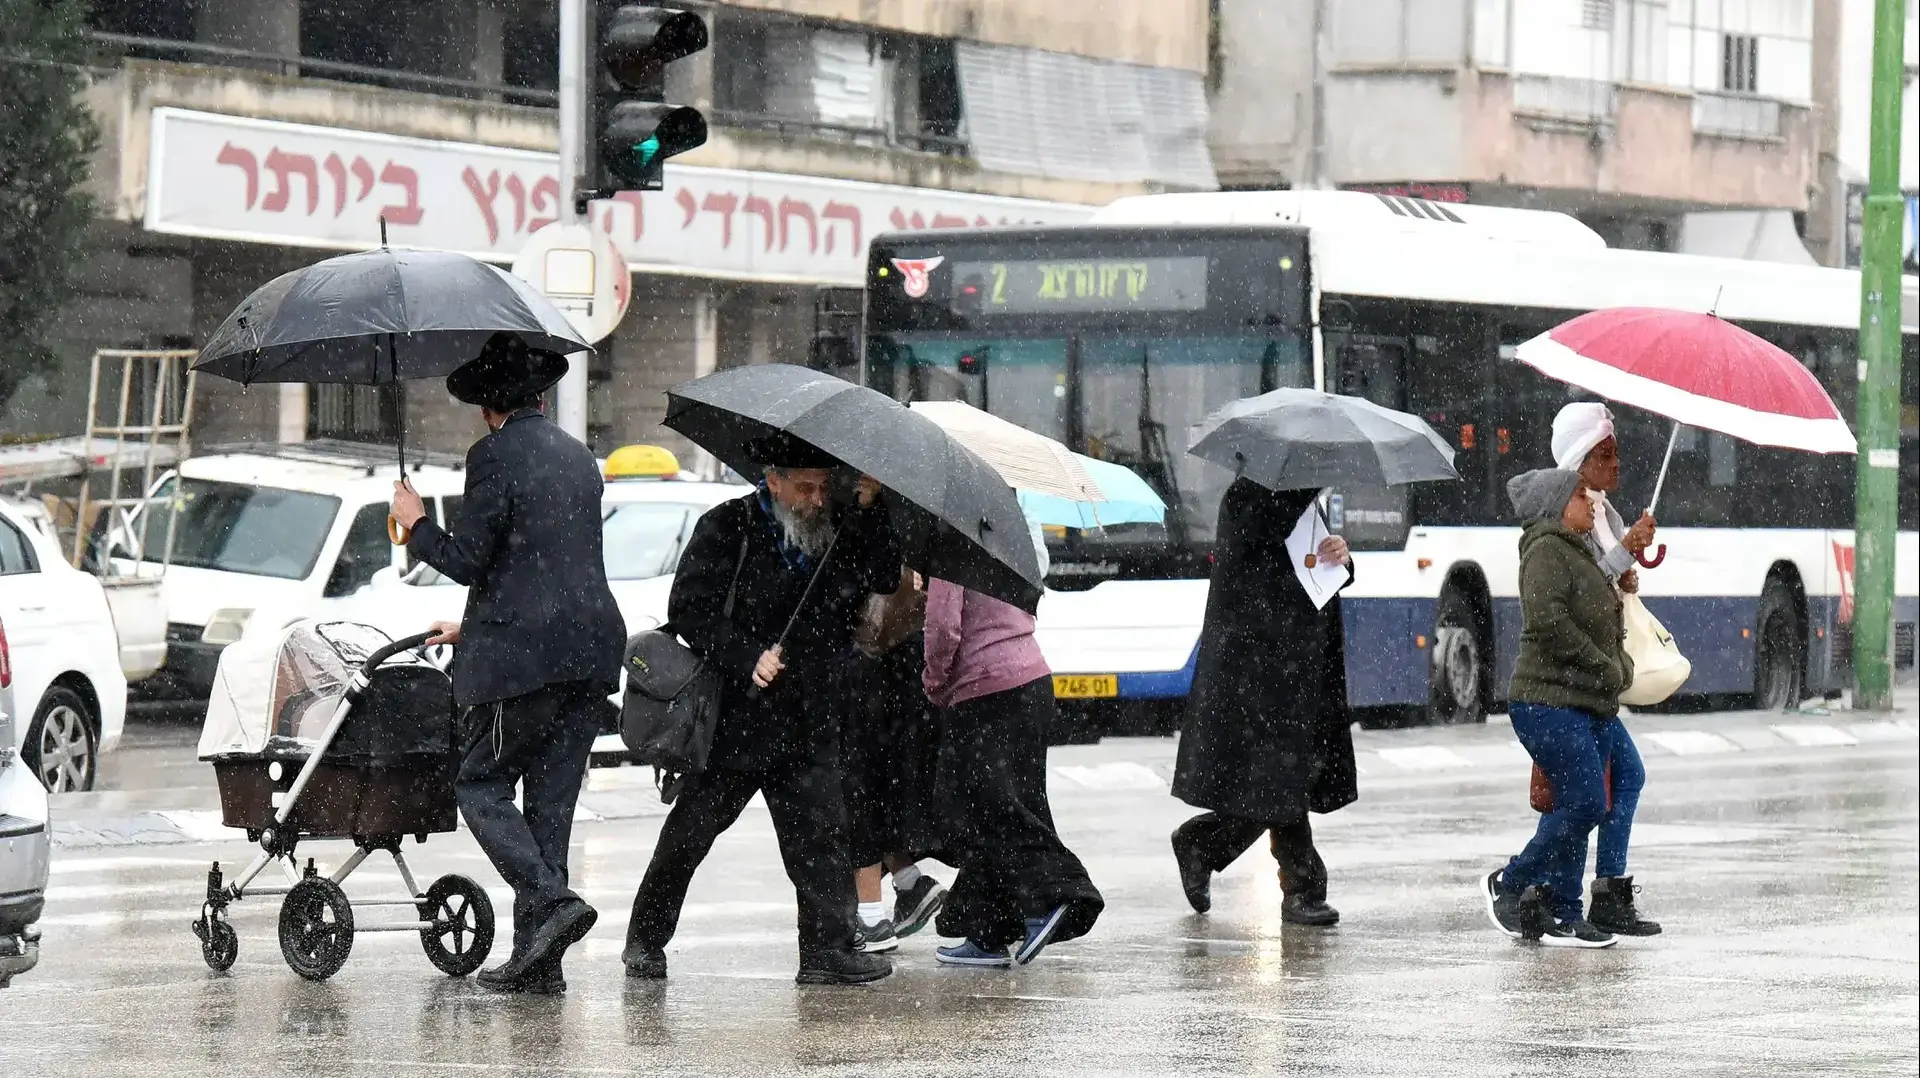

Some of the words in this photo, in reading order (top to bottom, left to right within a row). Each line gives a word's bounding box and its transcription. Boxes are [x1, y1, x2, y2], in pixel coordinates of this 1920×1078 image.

[216, 140, 425, 226] ביותר
[462, 165, 646, 246] הפוץ
[674, 187, 862, 258] החרדי
[993, 264, 1007, 304] 2
